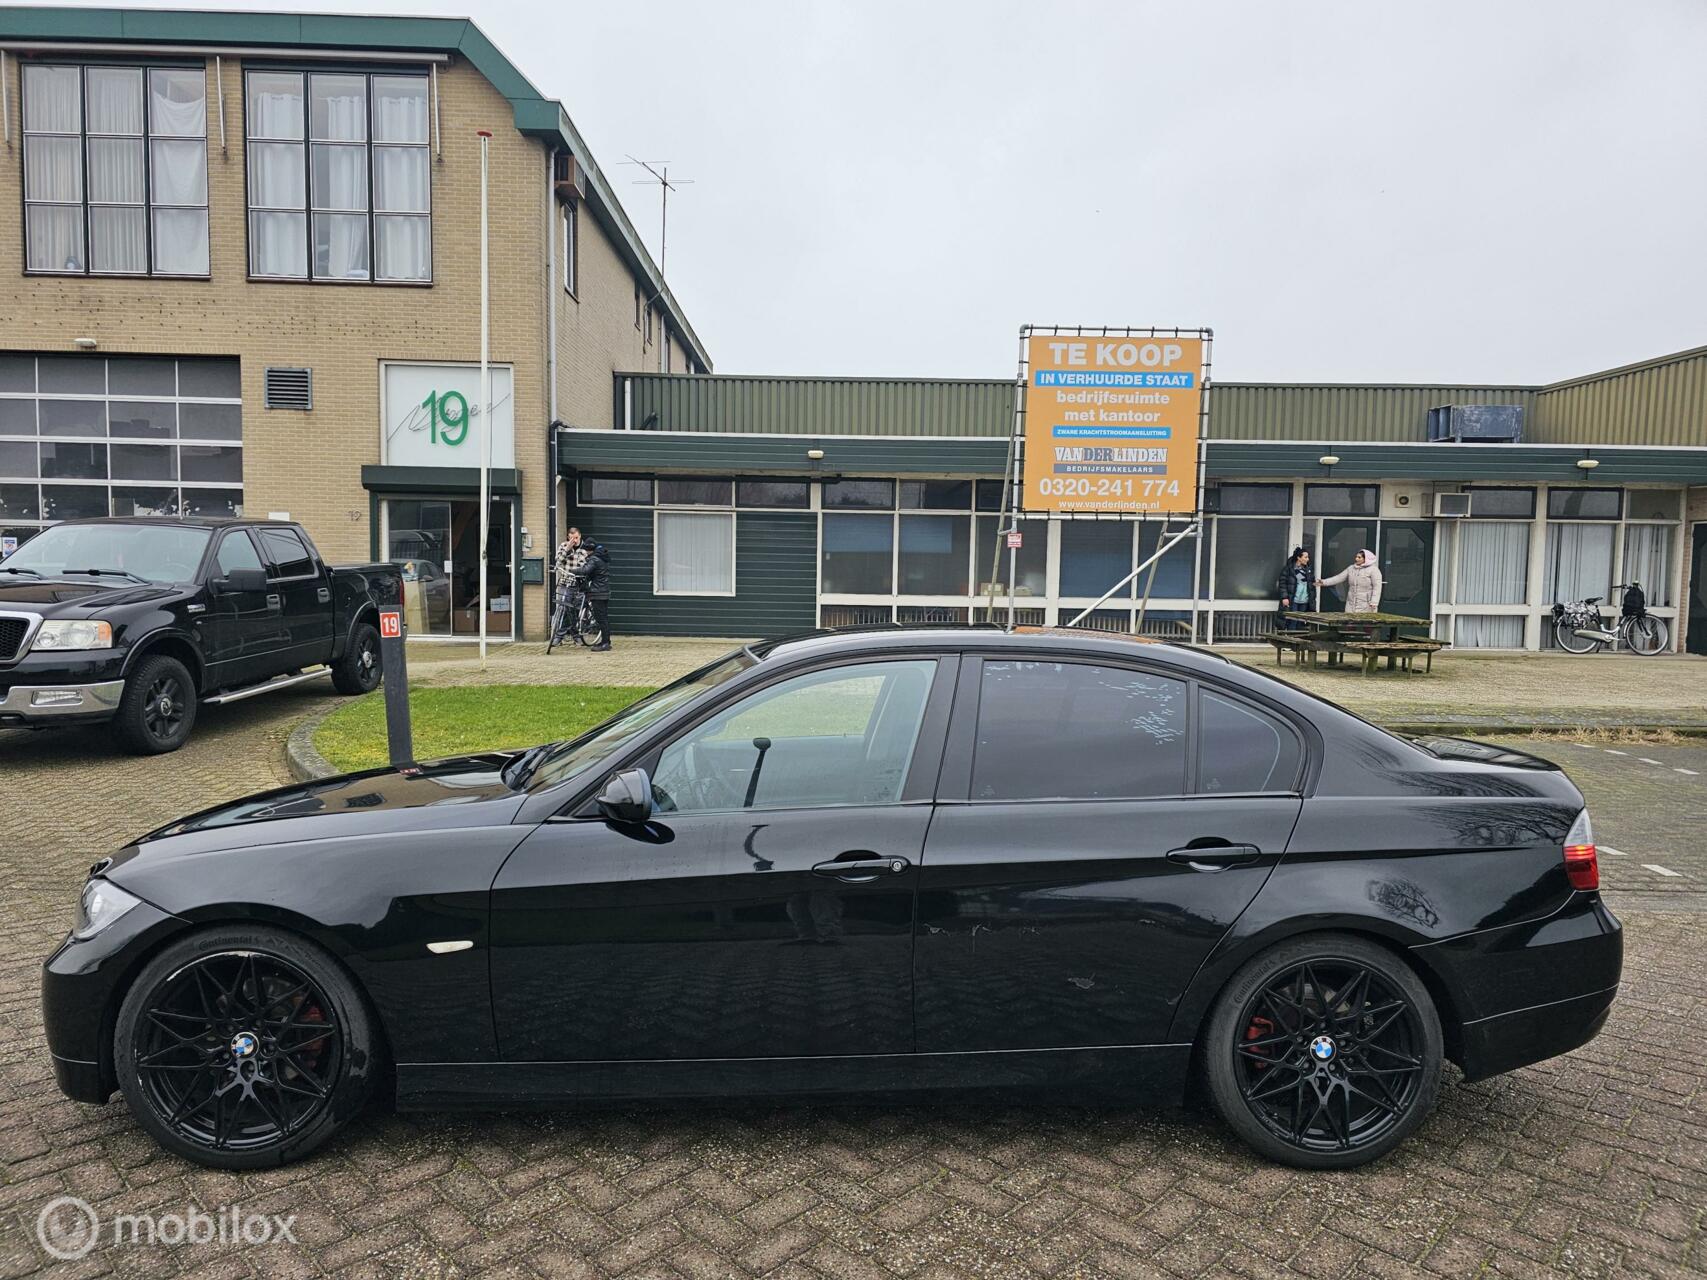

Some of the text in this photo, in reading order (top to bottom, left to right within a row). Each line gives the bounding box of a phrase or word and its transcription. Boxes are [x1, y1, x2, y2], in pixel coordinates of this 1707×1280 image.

[1049, 342, 1183, 367] TE KOOP
[1040, 373, 1188, 386] IN VERHUURDE STAAT
[1056, 390, 1170, 406] bedrijfsruimte
[422, 390, 469, 446] 19
[1064, 409, 1161, 422] met kantoor
[1066, 465, 1153, 473] BEDRIJFSMAKELAARS
[1039, 478, 1180, 497] 0320-241 774
[1058, 500, 1160, 510] www.vanderlinden.nl
[383, 616, 398, 633] 19
